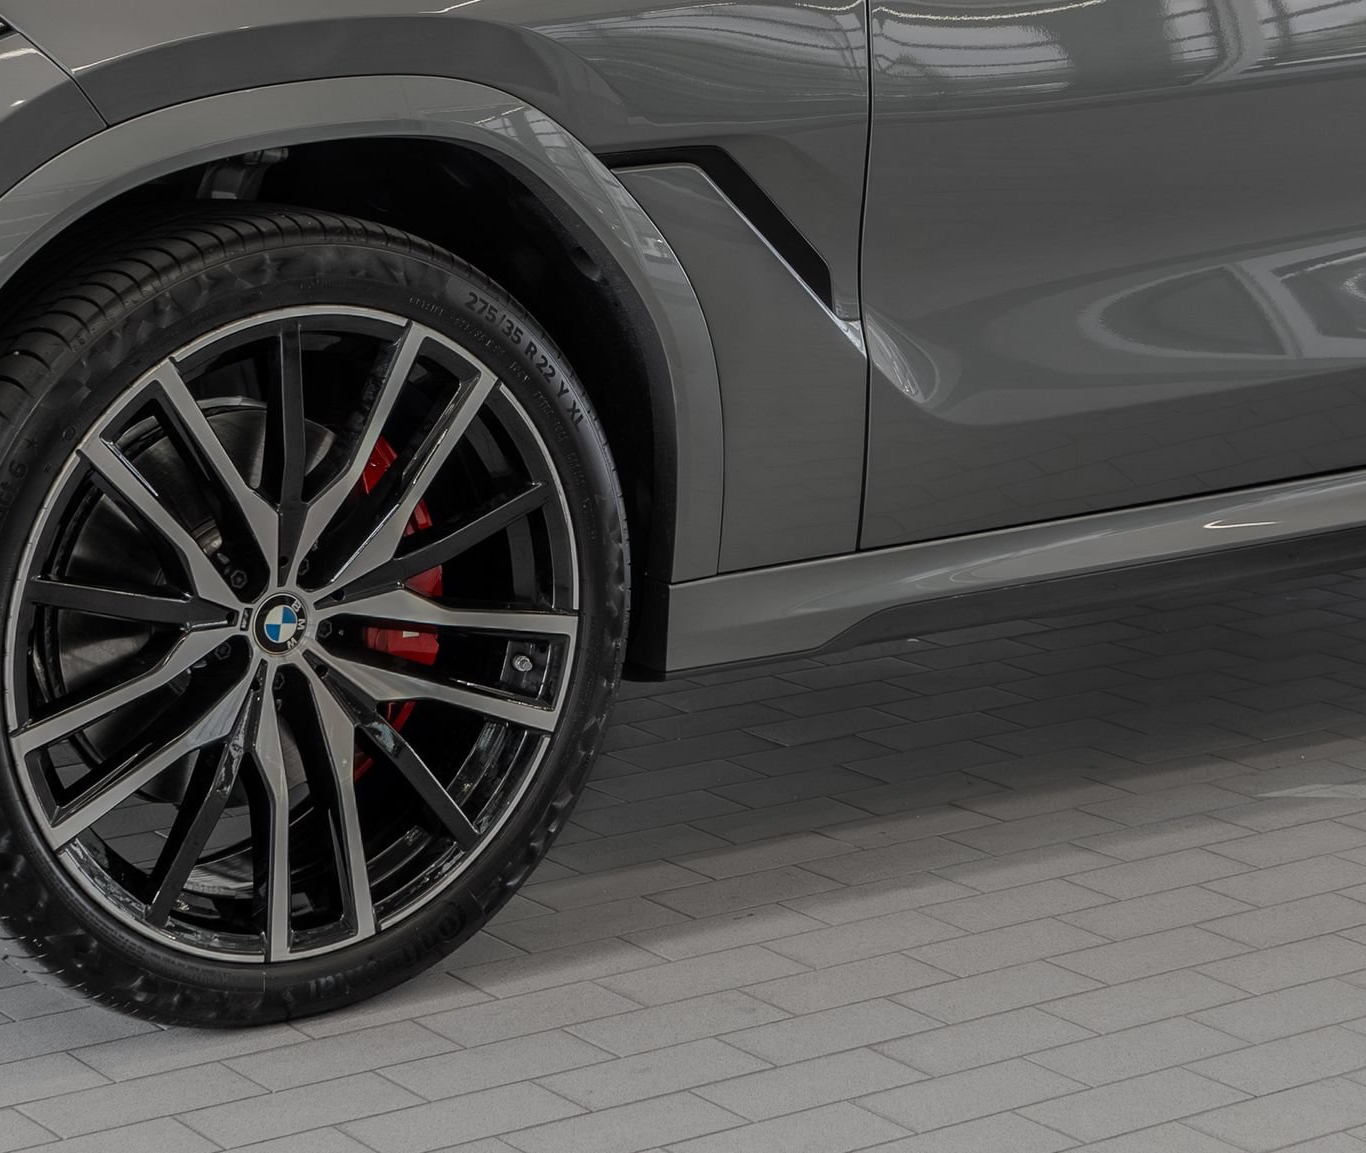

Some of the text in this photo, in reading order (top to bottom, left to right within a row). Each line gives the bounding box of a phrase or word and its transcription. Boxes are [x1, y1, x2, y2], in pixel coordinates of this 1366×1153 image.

[465, 292, 524, 345] 275/35
[524, 343, 538, 362] R
[536, 355, 556, 383] 22
[557, 381, 570, 397] Y
[567, 400, 584, 432] XL
[9, 458, 28, 479] 6
[287, 599, 306, 649] BMW
